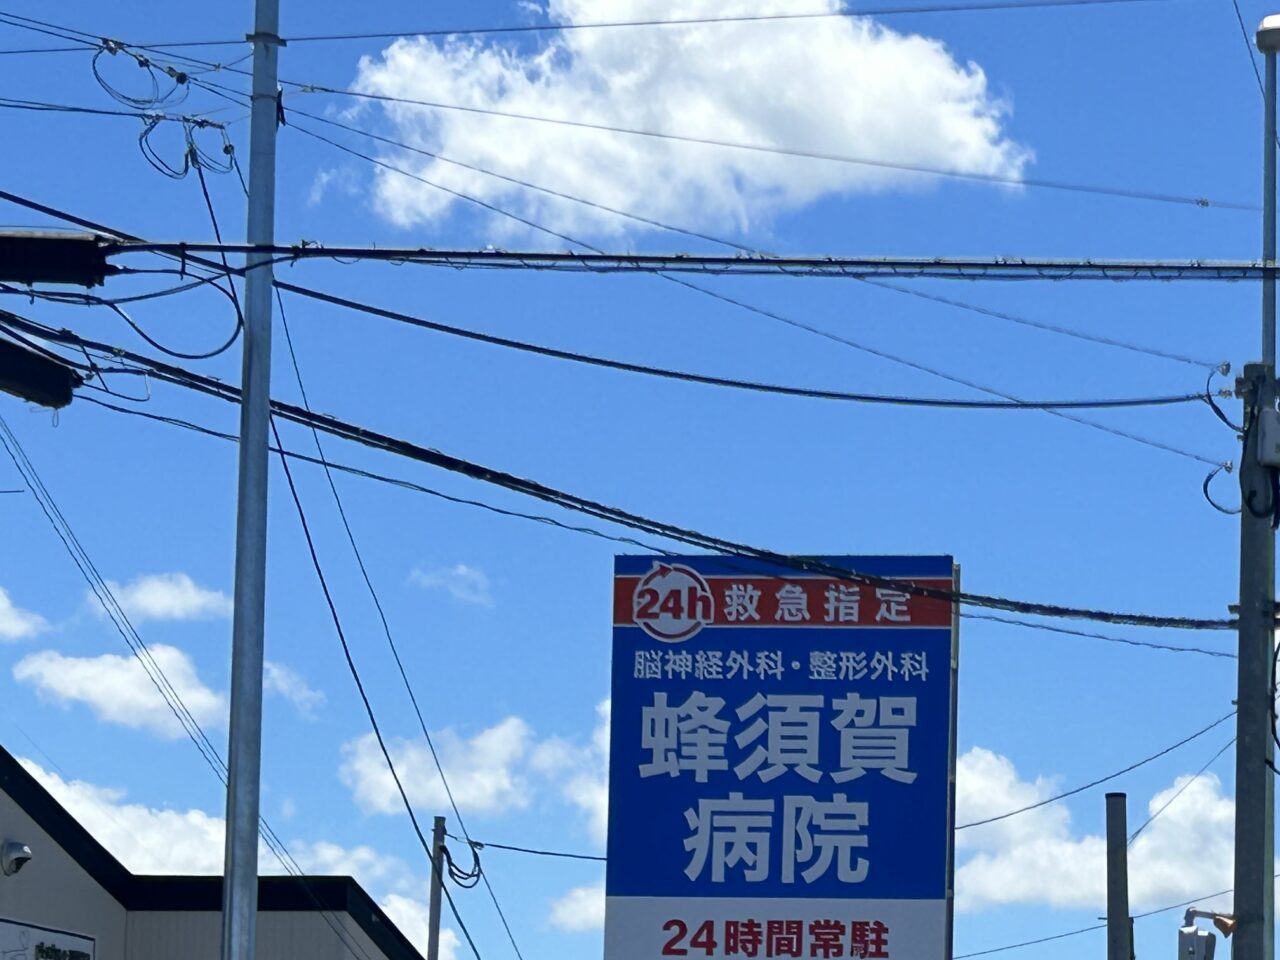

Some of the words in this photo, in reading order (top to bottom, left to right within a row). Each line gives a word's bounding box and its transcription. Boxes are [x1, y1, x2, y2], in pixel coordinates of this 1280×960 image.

[636, 587, 714, 621] 24h
[724, 584, 912, 623] 救急指定
[634, 650, 930, 682] 脳神経外科・整形外科
[639, 690, 919, 784] 蜂須賀
[683, 792, 870, 884] 病院
[661, 918, 890, 960] 24時間常駐
